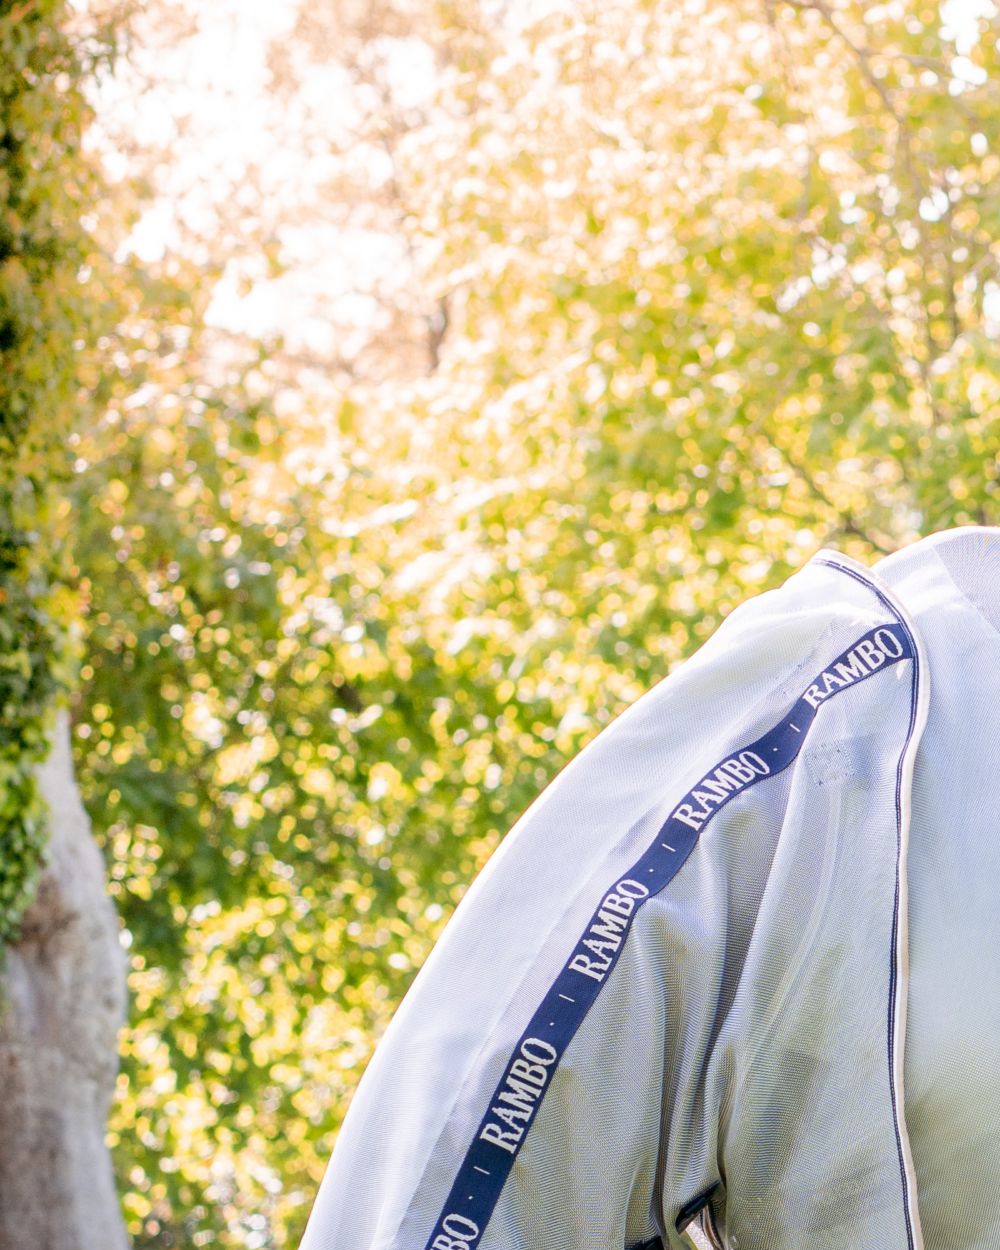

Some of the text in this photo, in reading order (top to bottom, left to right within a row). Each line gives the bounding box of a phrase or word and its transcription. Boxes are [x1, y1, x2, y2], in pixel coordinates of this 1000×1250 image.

[802, 629, 903, 709] RAMBO
[672, 751, 770, 831] RAMBO
[568, 879, 649, 982] RAMBO
[480, 1037, 557, 1154] RAMBO
